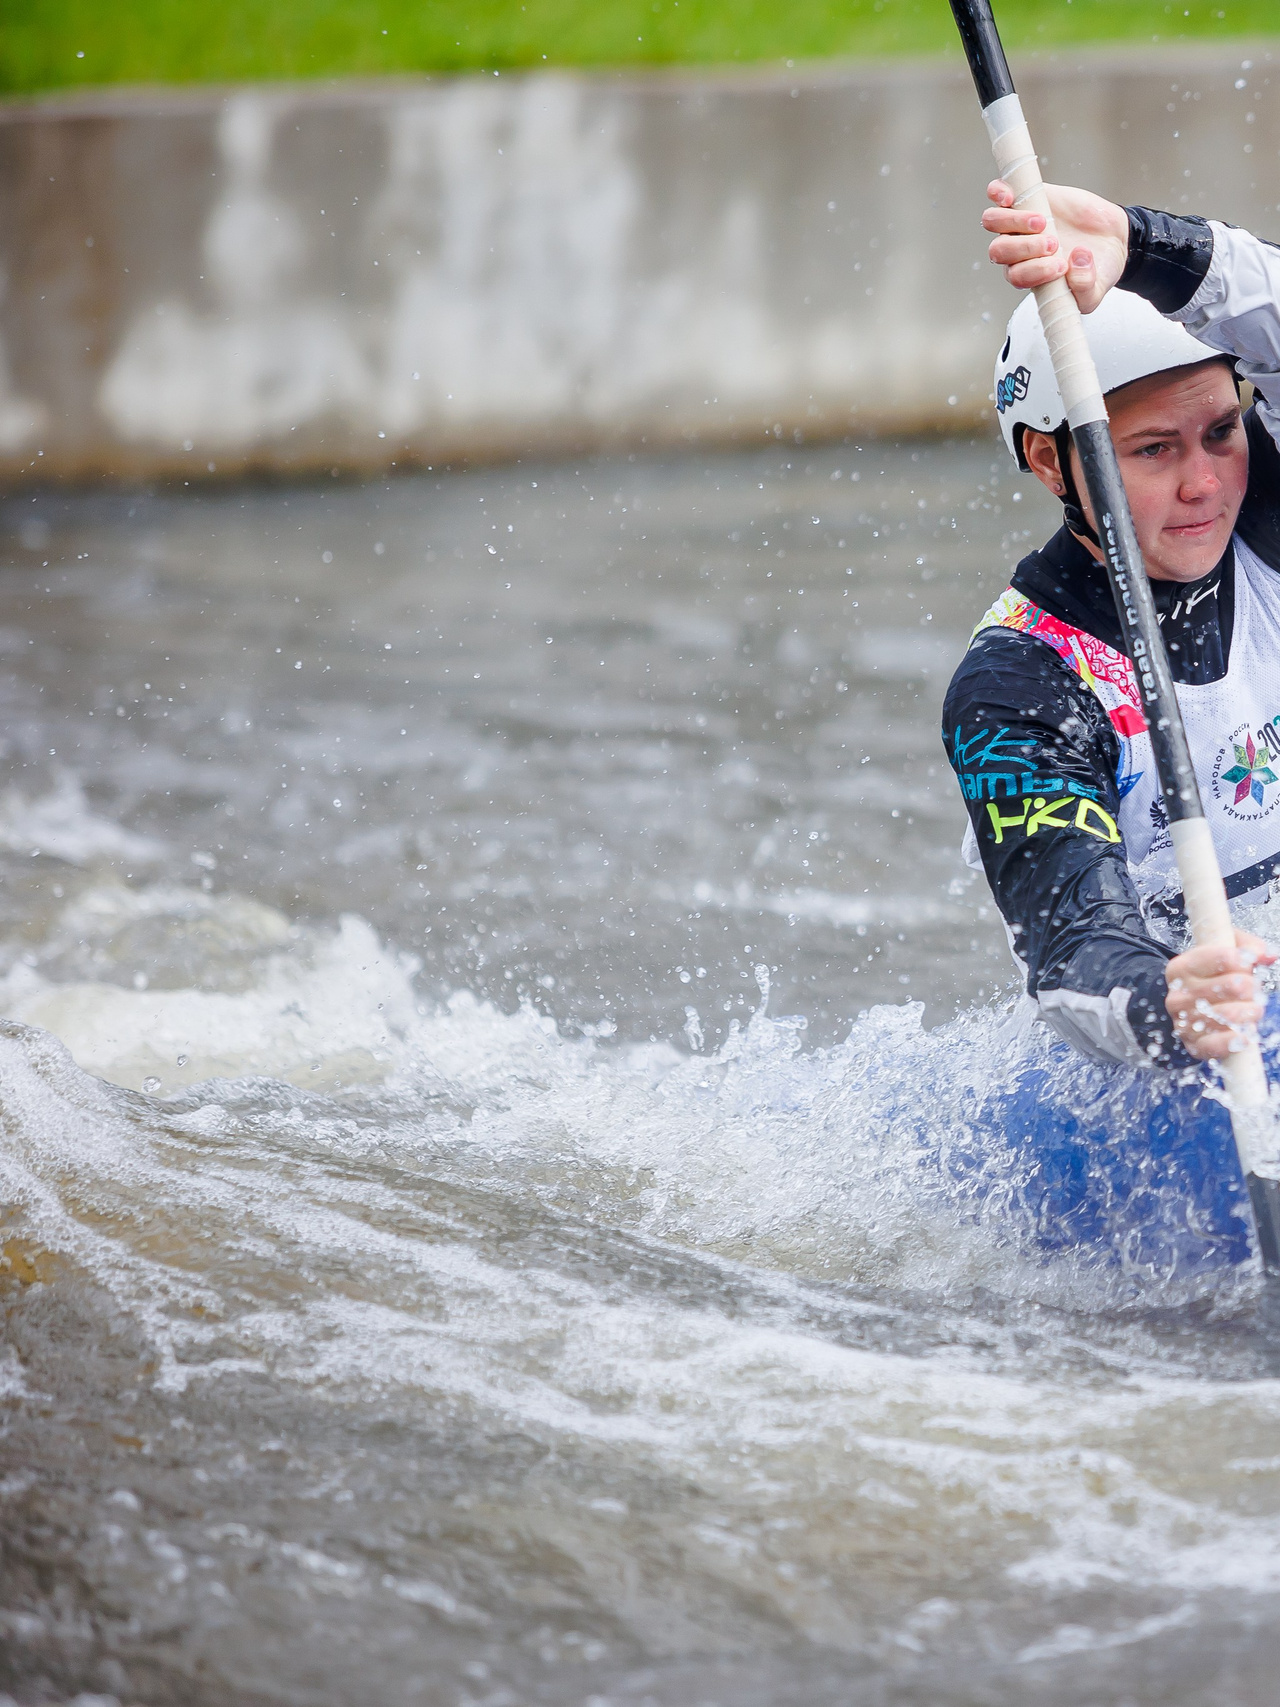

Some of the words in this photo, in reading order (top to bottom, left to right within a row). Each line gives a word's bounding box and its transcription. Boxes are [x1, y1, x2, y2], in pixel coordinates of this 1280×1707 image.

[1133, 637, 1159, 702] raab
[1211, 748, 1226, 800] НАРОДОВ
[1148, 840, 1174, 855] РОСС
